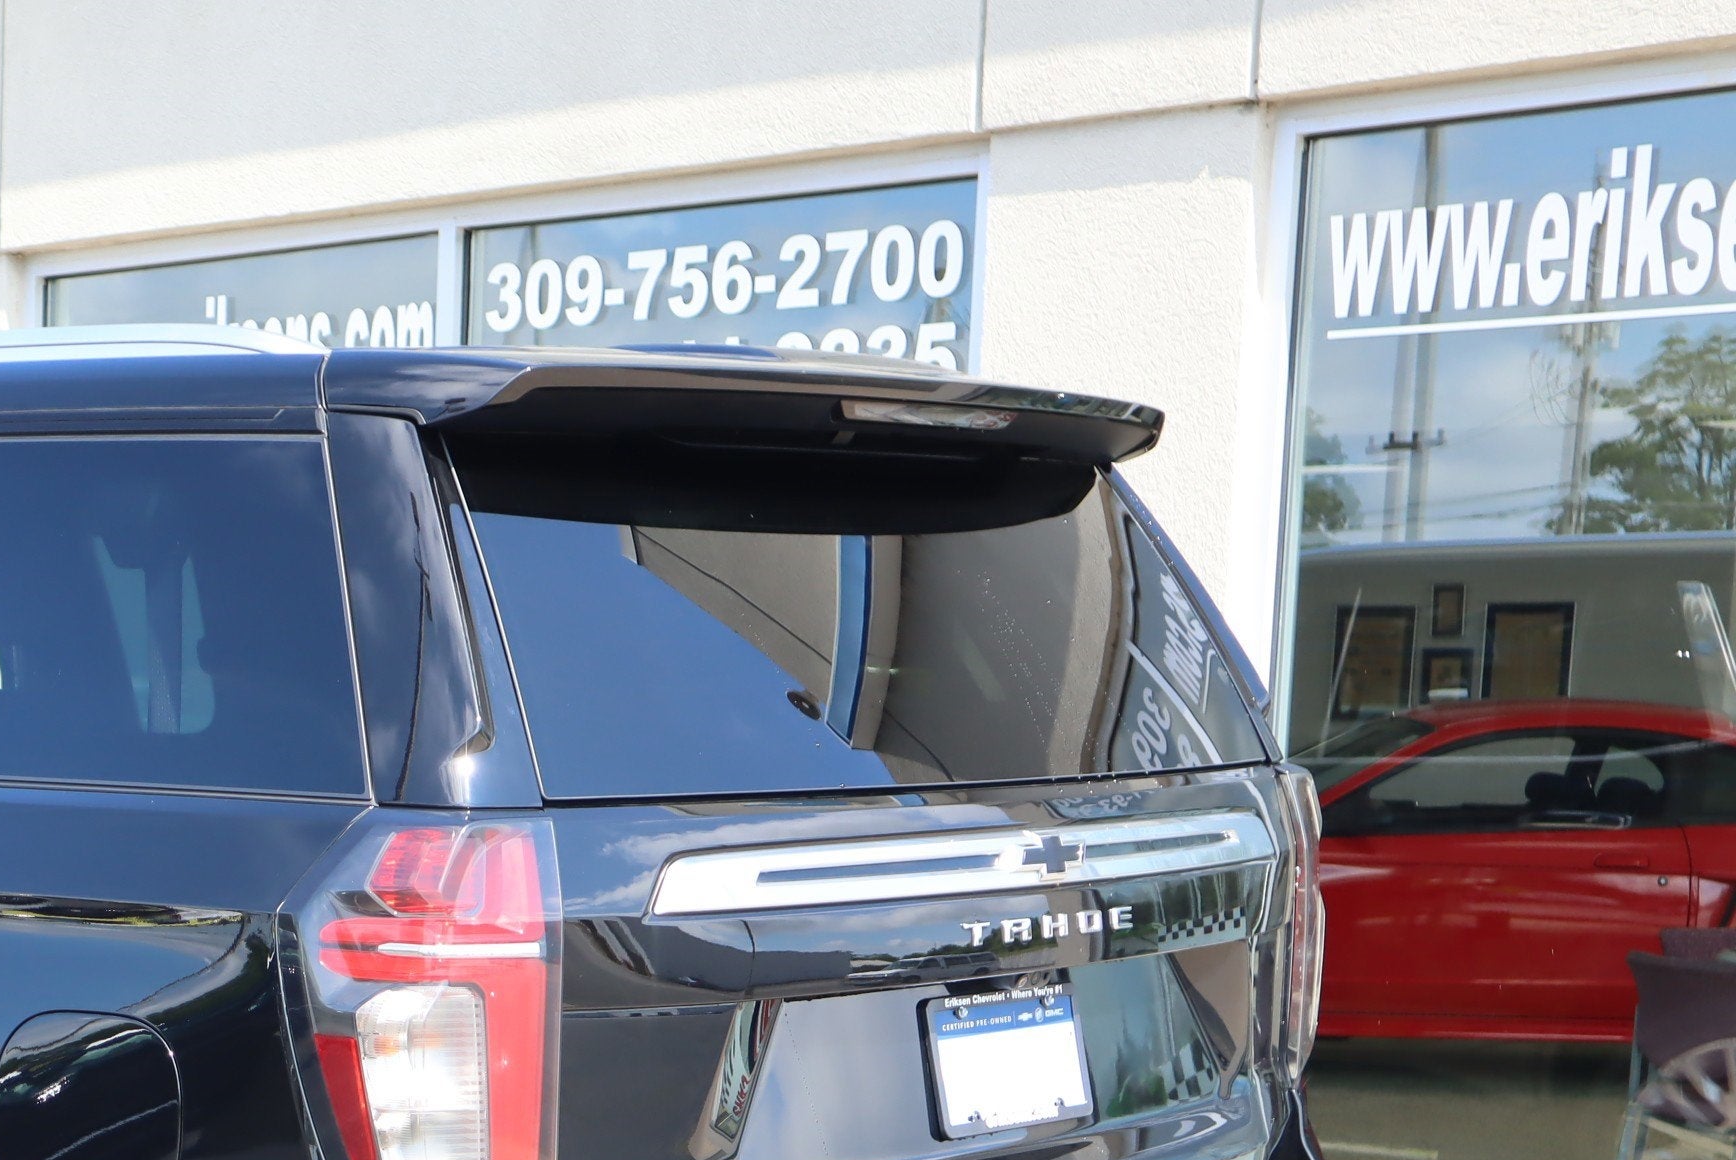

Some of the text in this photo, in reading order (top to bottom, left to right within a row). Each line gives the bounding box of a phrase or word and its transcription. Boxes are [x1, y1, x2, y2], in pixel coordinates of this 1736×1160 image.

[485, 218, 965, 333] 309-756-2700
[959, 905, 1134, 948] TAHOE
[944, 996, 971, 1009] Eriksen
[972, 992, 1006, 1005] Chevrolet
[1011, 988, 1033, 1000] Where
[1034, 985, 1054, 997] You're
[942, 1007, 1064, 1032] CERTIFIED PRE-OWNED GMC
